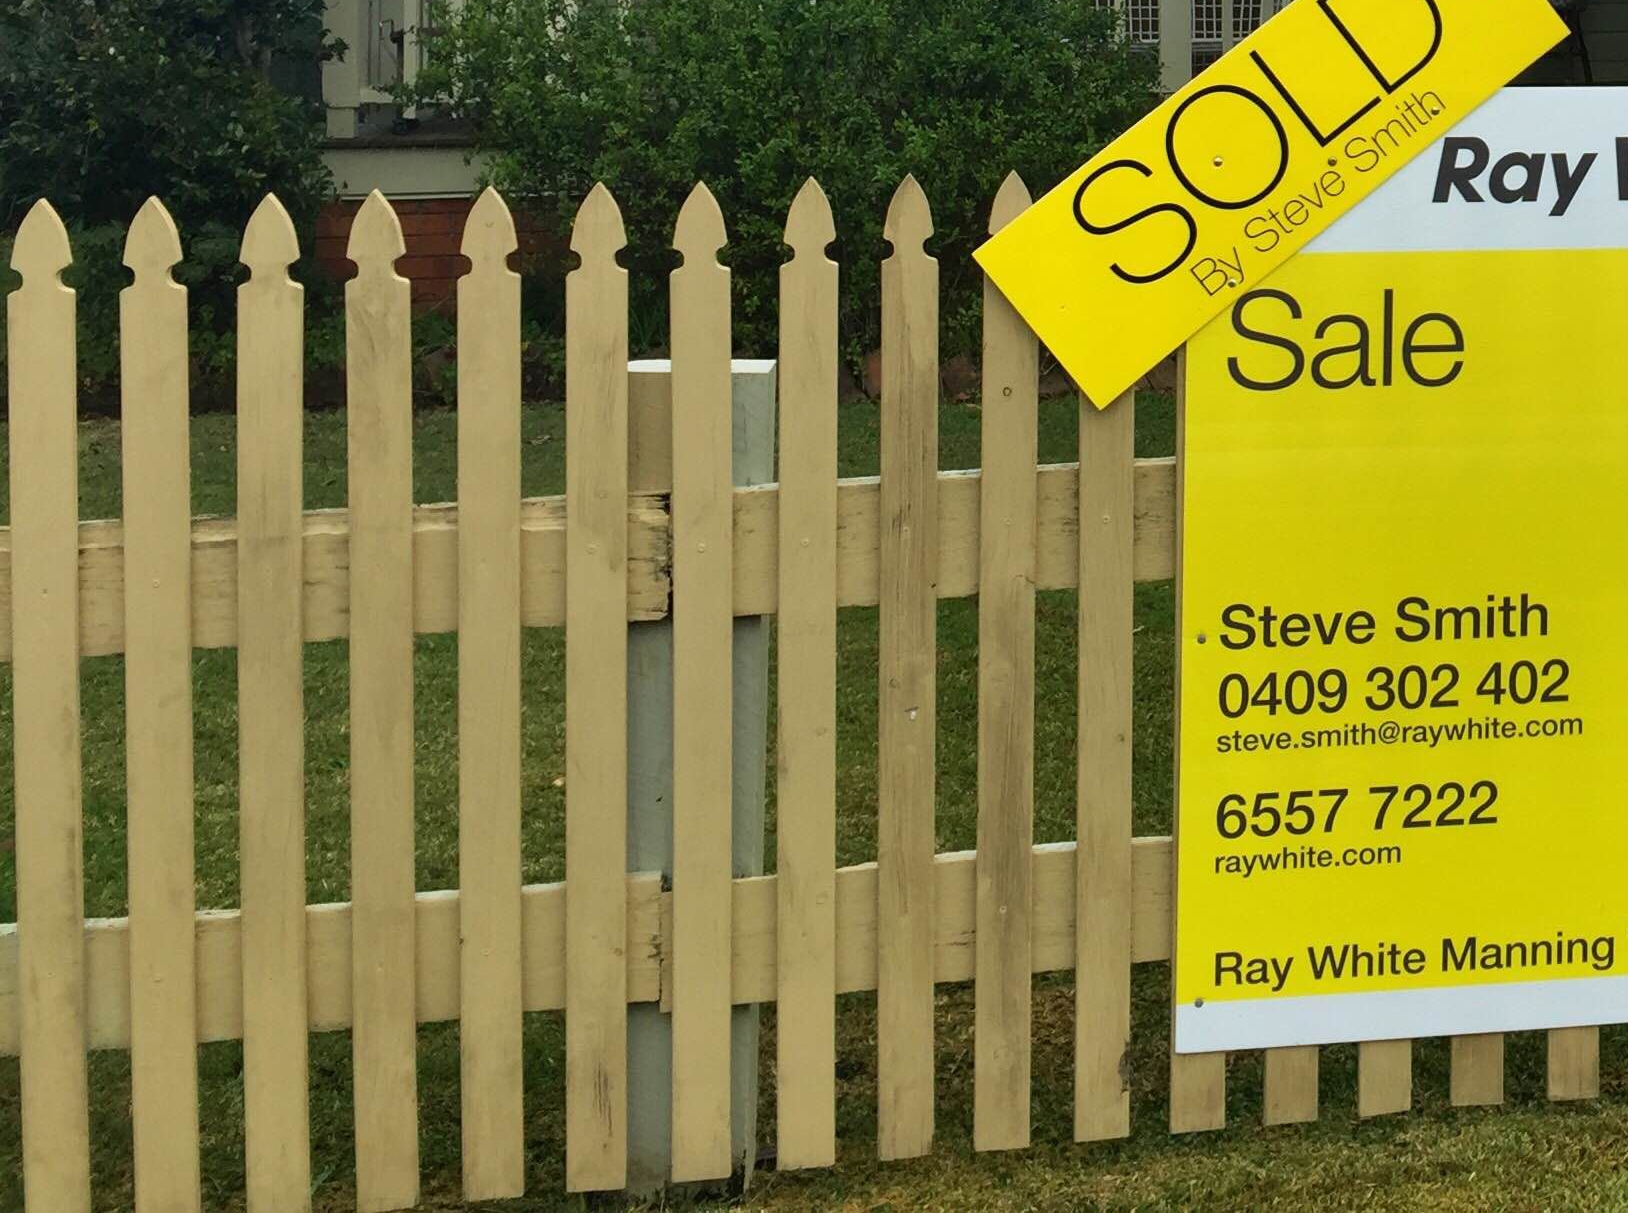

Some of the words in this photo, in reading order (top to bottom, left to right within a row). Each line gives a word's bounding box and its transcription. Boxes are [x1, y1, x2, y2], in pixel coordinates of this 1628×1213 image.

[1190, 246, 1245, 297] By
[1244, 170, 1345, 253] Steve
[1344, 91, 1446, 173] Smith
[1431, 136, 1599, 217] Ray
[1227, 289, 1465, 392] Sale
[1219, 603, 1376, 650] Steve
[1394, 593, 1548, 643] Smith
[1218, 668, 1348, 719] 0409
[1364, 663, 1460, 712] 302
[1476, 658, 1570, 706] 402
[1216, 714, 1583, 753] steve.smith@raywhite.com
[1216, 788, 1349, 840] 6557
[1368, 780, 1498, 830] 7222
[1215, 846, 1401, 878] raywhite.com
[1214, 951, 1294, 992] Ray
[1307, 942, 1426, 980] White
[1441, 931, 1615, 972] Manning
